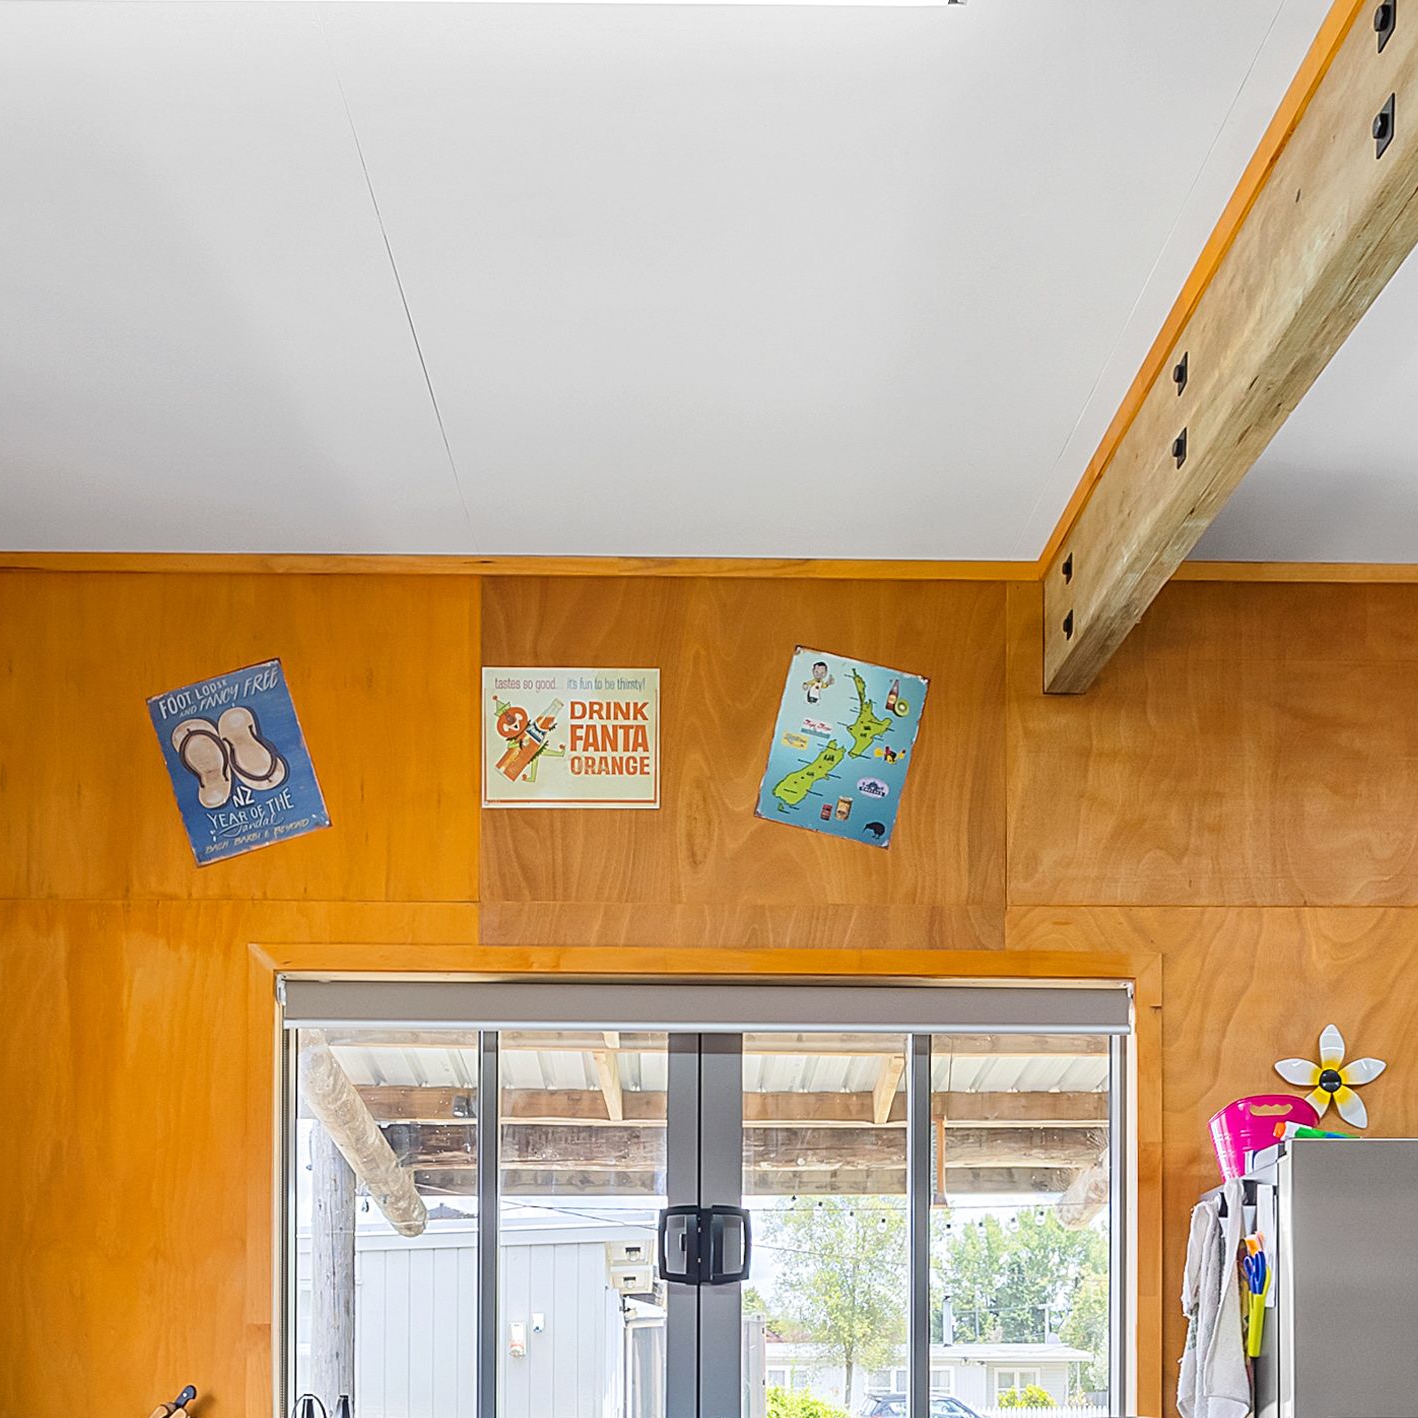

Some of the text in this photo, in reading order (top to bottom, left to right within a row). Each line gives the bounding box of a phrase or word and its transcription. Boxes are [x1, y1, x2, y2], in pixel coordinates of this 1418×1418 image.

[179, 667, 279, 718] AND FANCY FREE
[495, 678, 520, 690] tastes
[523, 681, 533, 690] so
[567, 678, 577, 690] it's
[579, 678, 593, 690] fun
[595, 678, 603, 690] to
[605, 678, 615, 690] be
[617, 678, 646, 692] thirsty!
[158, 679, 228, 719] FOOT LOOSE
[570, 701, 649, 721] DRINK
[570, 724, 650, 752] FANTA
[570, 756, 650, 775] ORANGE
[207, 788, 295, 829] YEAR OF THE
[233, 785, 255, 807] NZ
